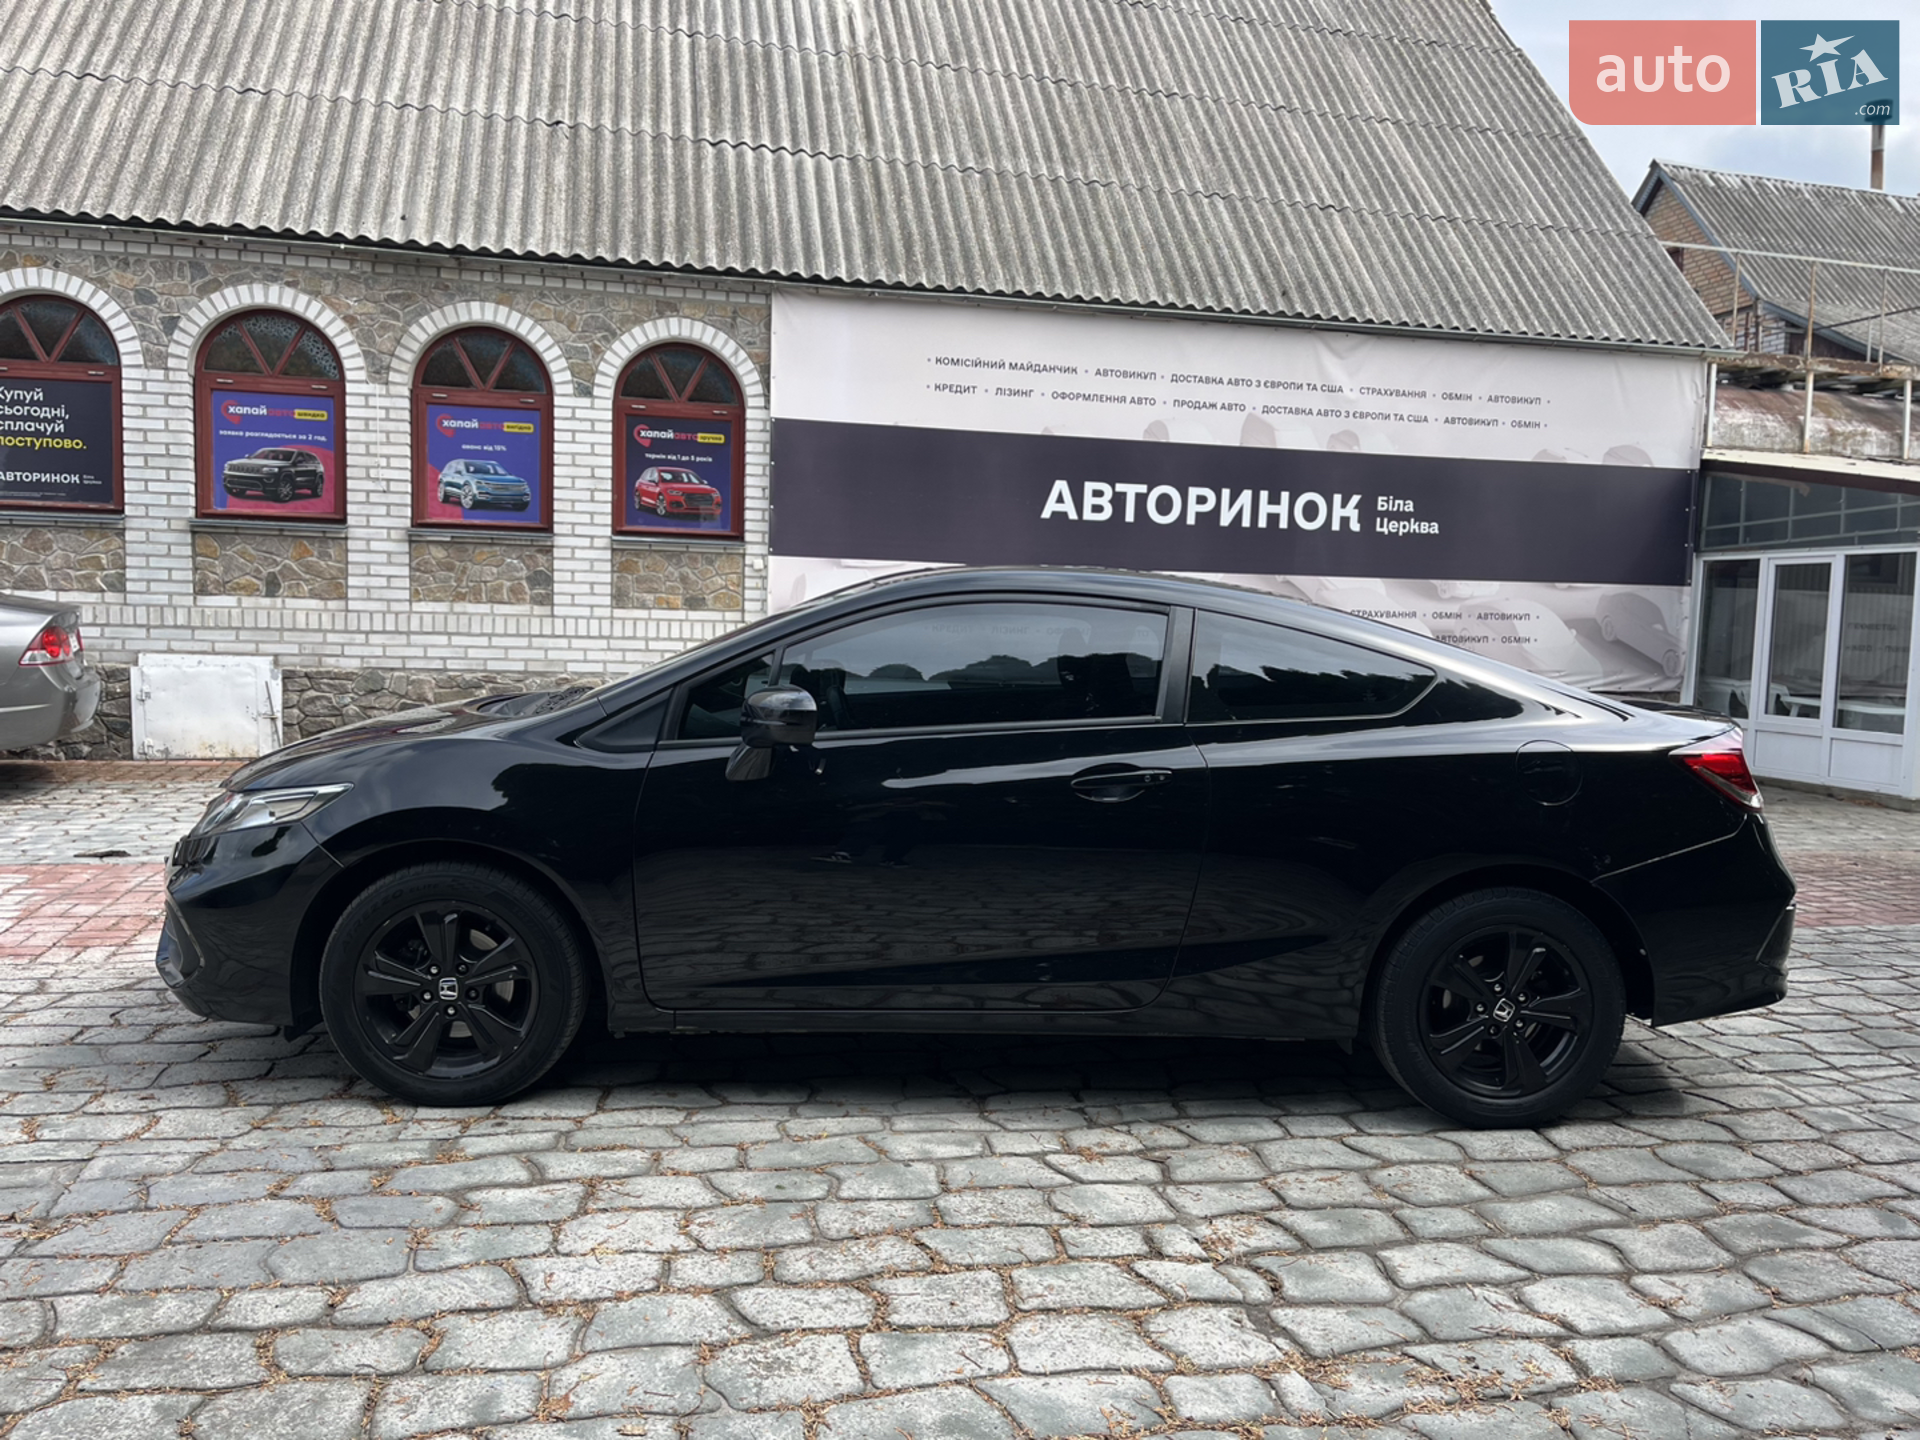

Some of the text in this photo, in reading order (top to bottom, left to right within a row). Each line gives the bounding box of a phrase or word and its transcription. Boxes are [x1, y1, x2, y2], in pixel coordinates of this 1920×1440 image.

[935, 356, 1078, 375] КОМІСІЙНИЙ МАЙДАНЧИК
[1094, 368, 1157, 380] АВТОВИКУП
[934, 383, 978, 394] КРЕДИТ
[1170, 373, 1224, 386] ДОСТАВКА
[1226, 378, 1253, 388] АВТО
[1264, 380, 1304, 391] ЄВРОПИ
[1306, 383, 1318, 392] ТА
[1320, 384, 1344, 394] США
[995, 387, 1034, 398] ЛІЗИНГ
[1360, 386, 1427, 398] СТРАХУВАННЯ
[1441, 392, 1472, 401] ОБМІН
[1052, 391, 1156, 406] ОФОРМЛЕННЯ АВТО
[1487, 394, 1542, 405] АВТОВИКУП
[1173, 399, 1246, 412] ПРОДАЖ АВТО
[1262, 404, 1314, 416] ДОСТАВКА
[1316, 409, 1342, 418] АВТО
[1352, 410, 1391, 421] ЄВРОПИ
[1393, 414, 1406, 422] ТА
[1407, 414, 1429, 424] США
[1444, 416, 1499, 428] АВТОВИКУП
[1510, 420, 1541, 429] ОБМІН
[1040, 478, 1363, 532] АВТОРИНОК
[1376, 496, 1414, 513] Біла
[1375, 516, 1440, 536] Церква
[1432, 611, 1462, 620] ОБМІН
[1476, 612, 1530, 622] АВТОВИКУП
[1501, 636, 1530, 644] ОБМІН
